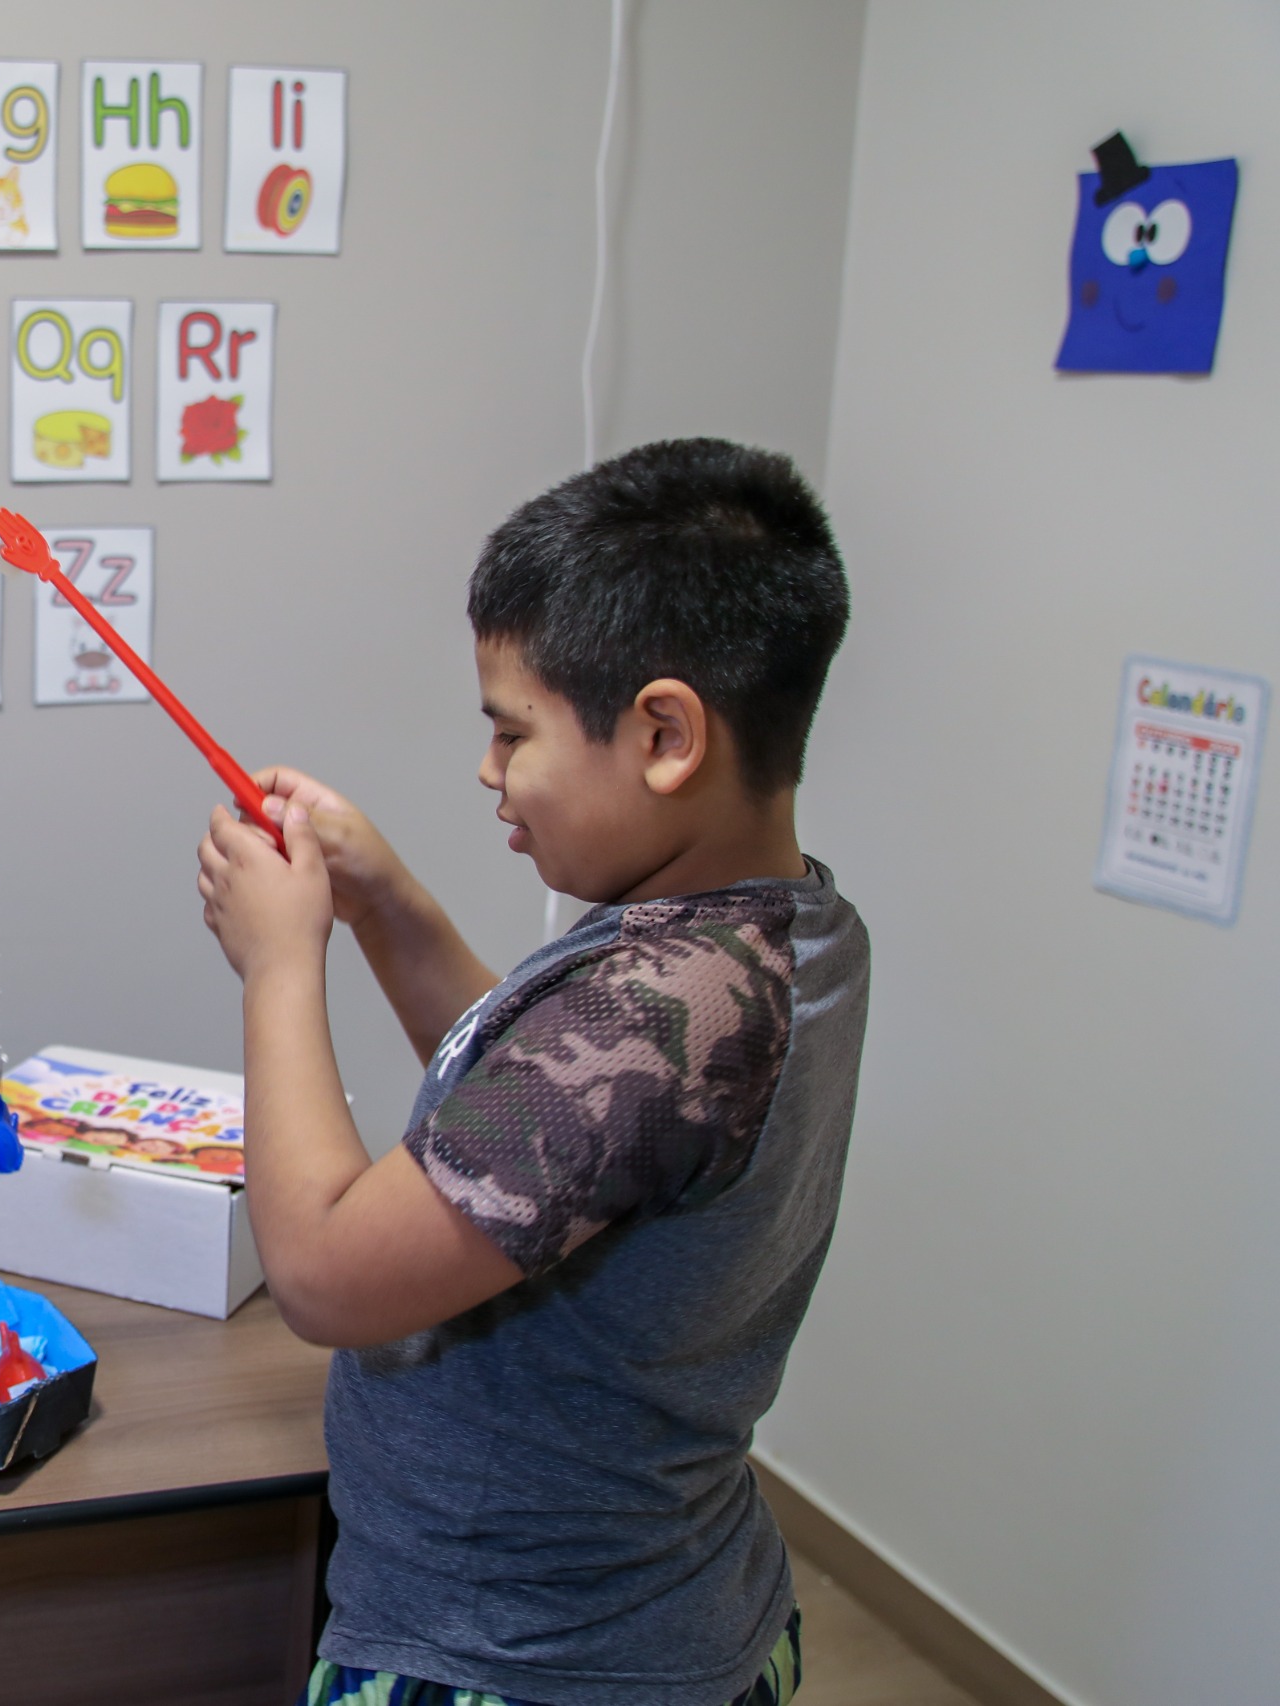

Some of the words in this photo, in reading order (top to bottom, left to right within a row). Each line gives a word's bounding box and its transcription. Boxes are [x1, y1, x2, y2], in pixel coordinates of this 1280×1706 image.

[93, 72, 191, 150] Hh
[272, 79, 306, 150] Ii
[16, 310, 124, 403] Qq
[178, 311, 256, 381] Rr
[53, 539, 136, 606] Zz
[92, 1091, 149, 1108] DIA
[157, 1103, 215, 1120] DAS
[129, 1083, 211, 1106] Feliz
